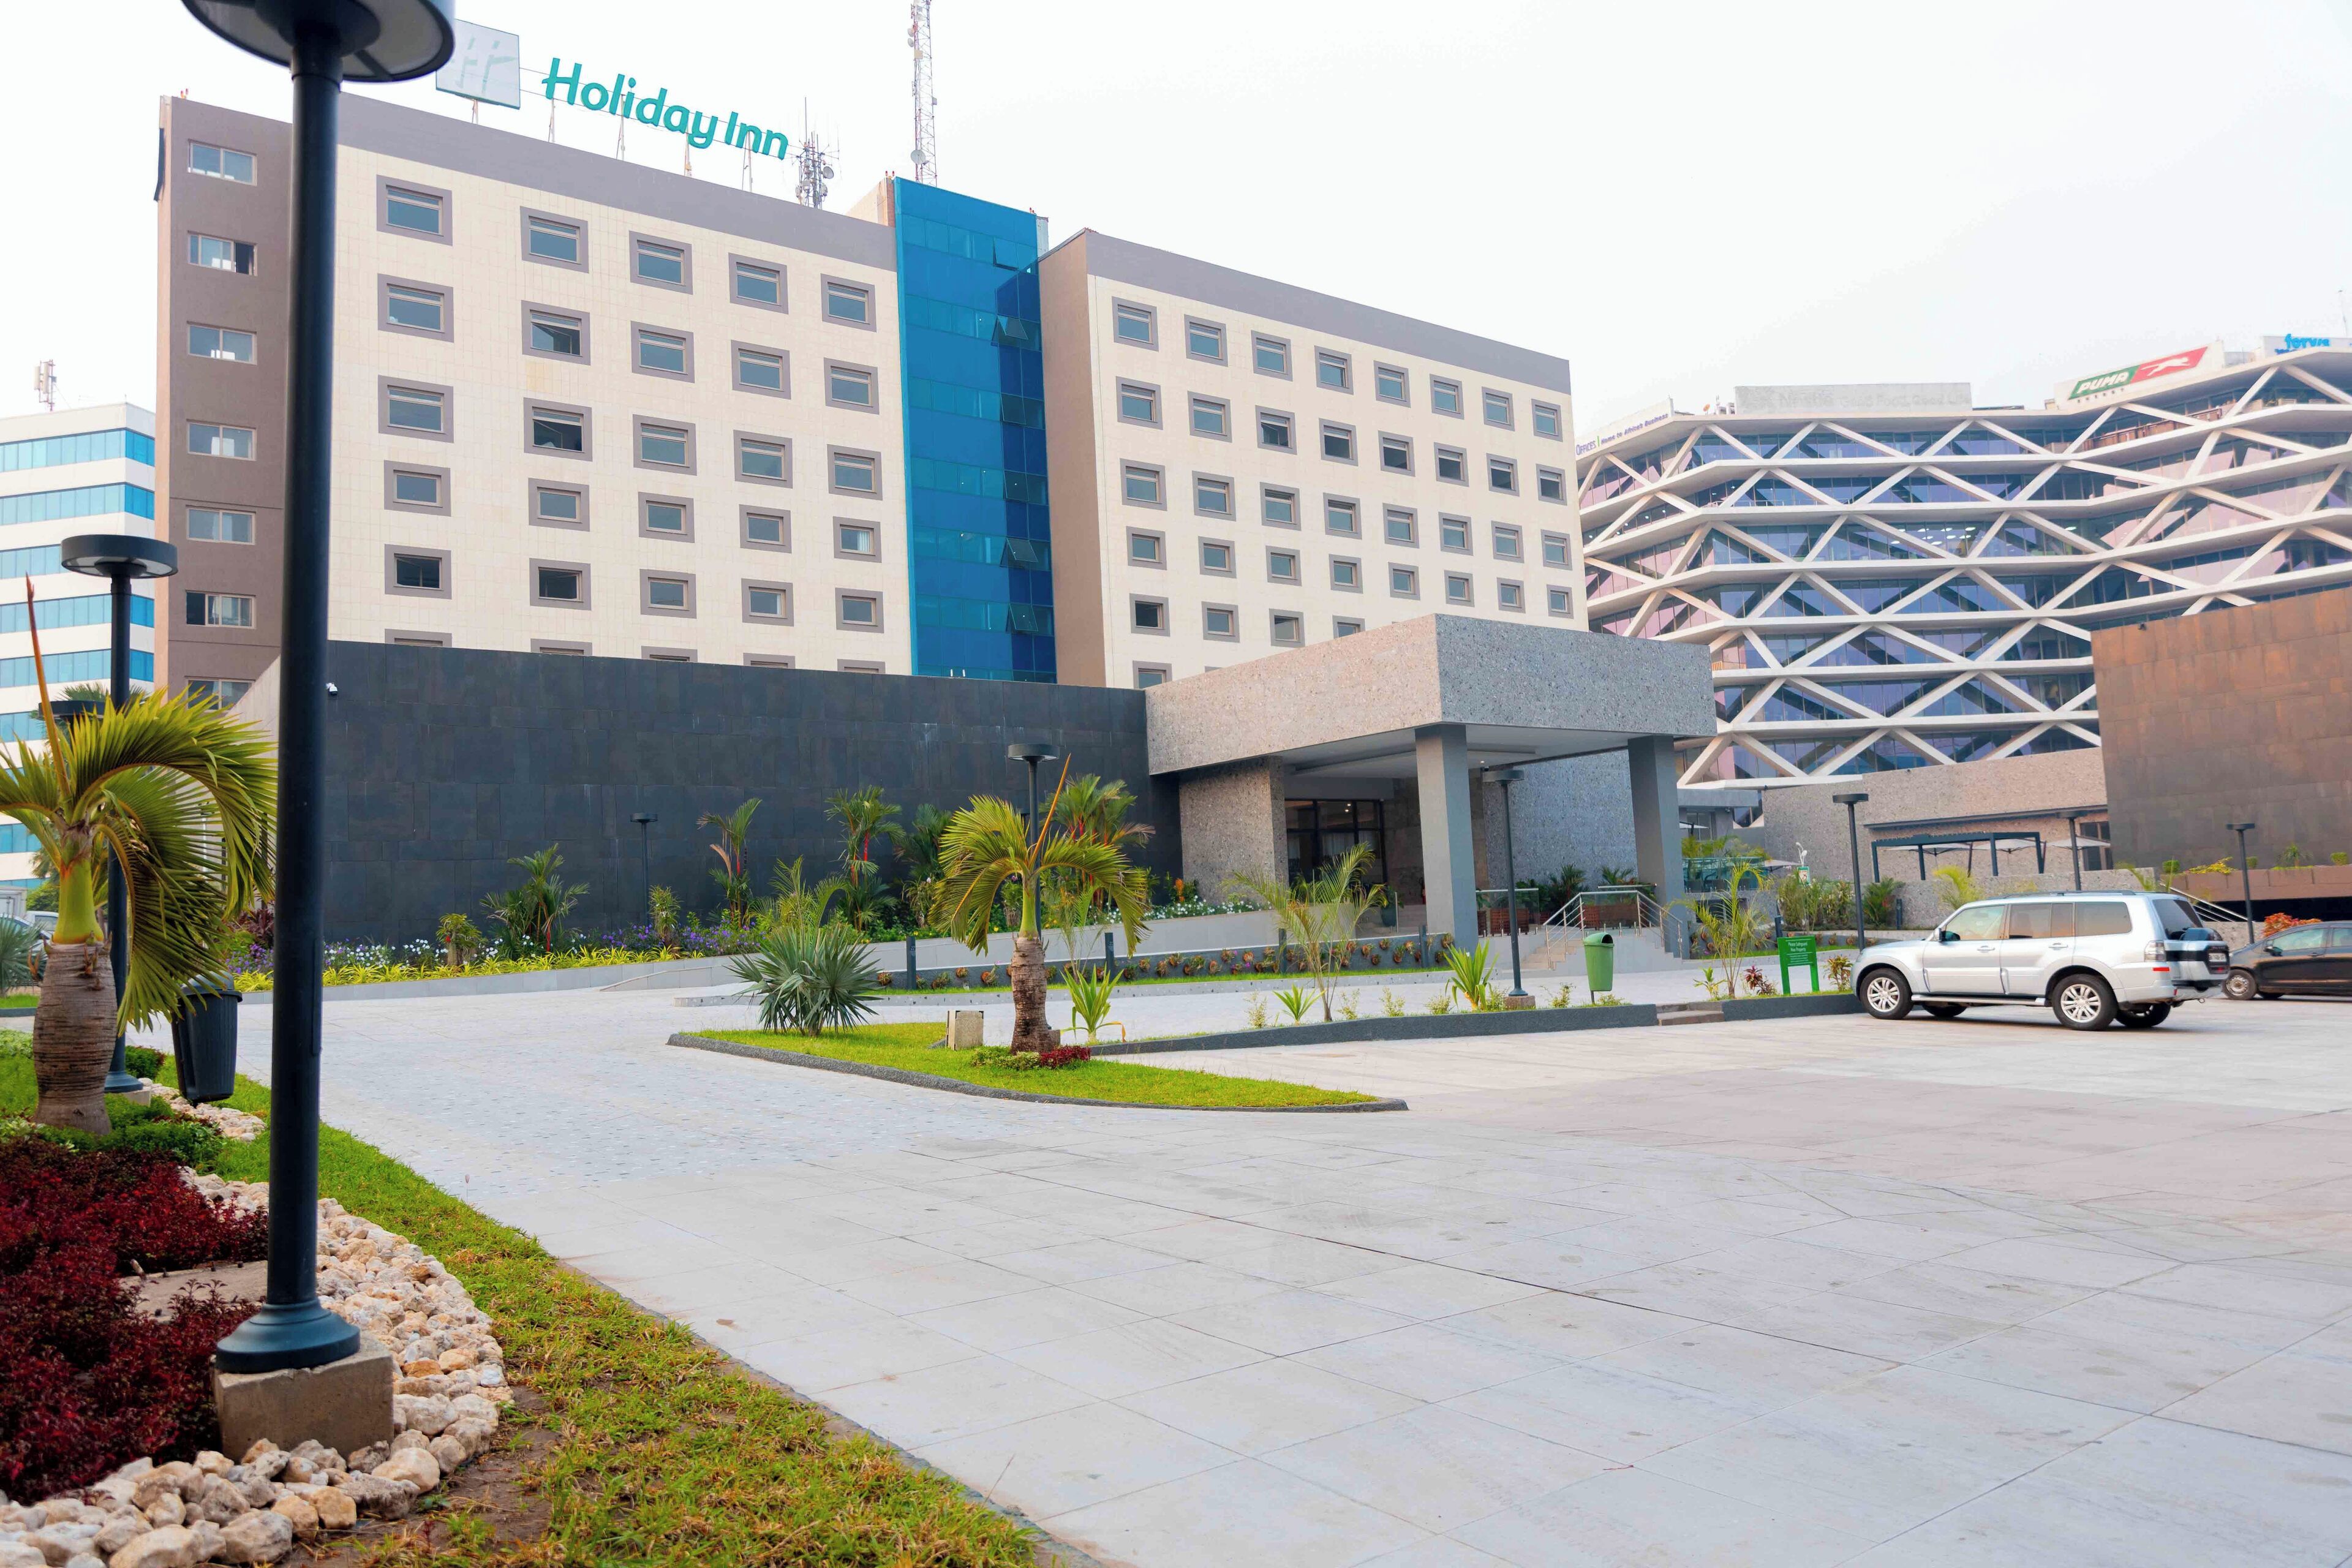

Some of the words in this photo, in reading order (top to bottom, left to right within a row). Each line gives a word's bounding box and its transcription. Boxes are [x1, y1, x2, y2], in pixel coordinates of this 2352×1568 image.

[541, 58, 718, 149] Holiday
[725, 111, 789, 160] Inn
[2076, 371, 2129, 393] PUMA
